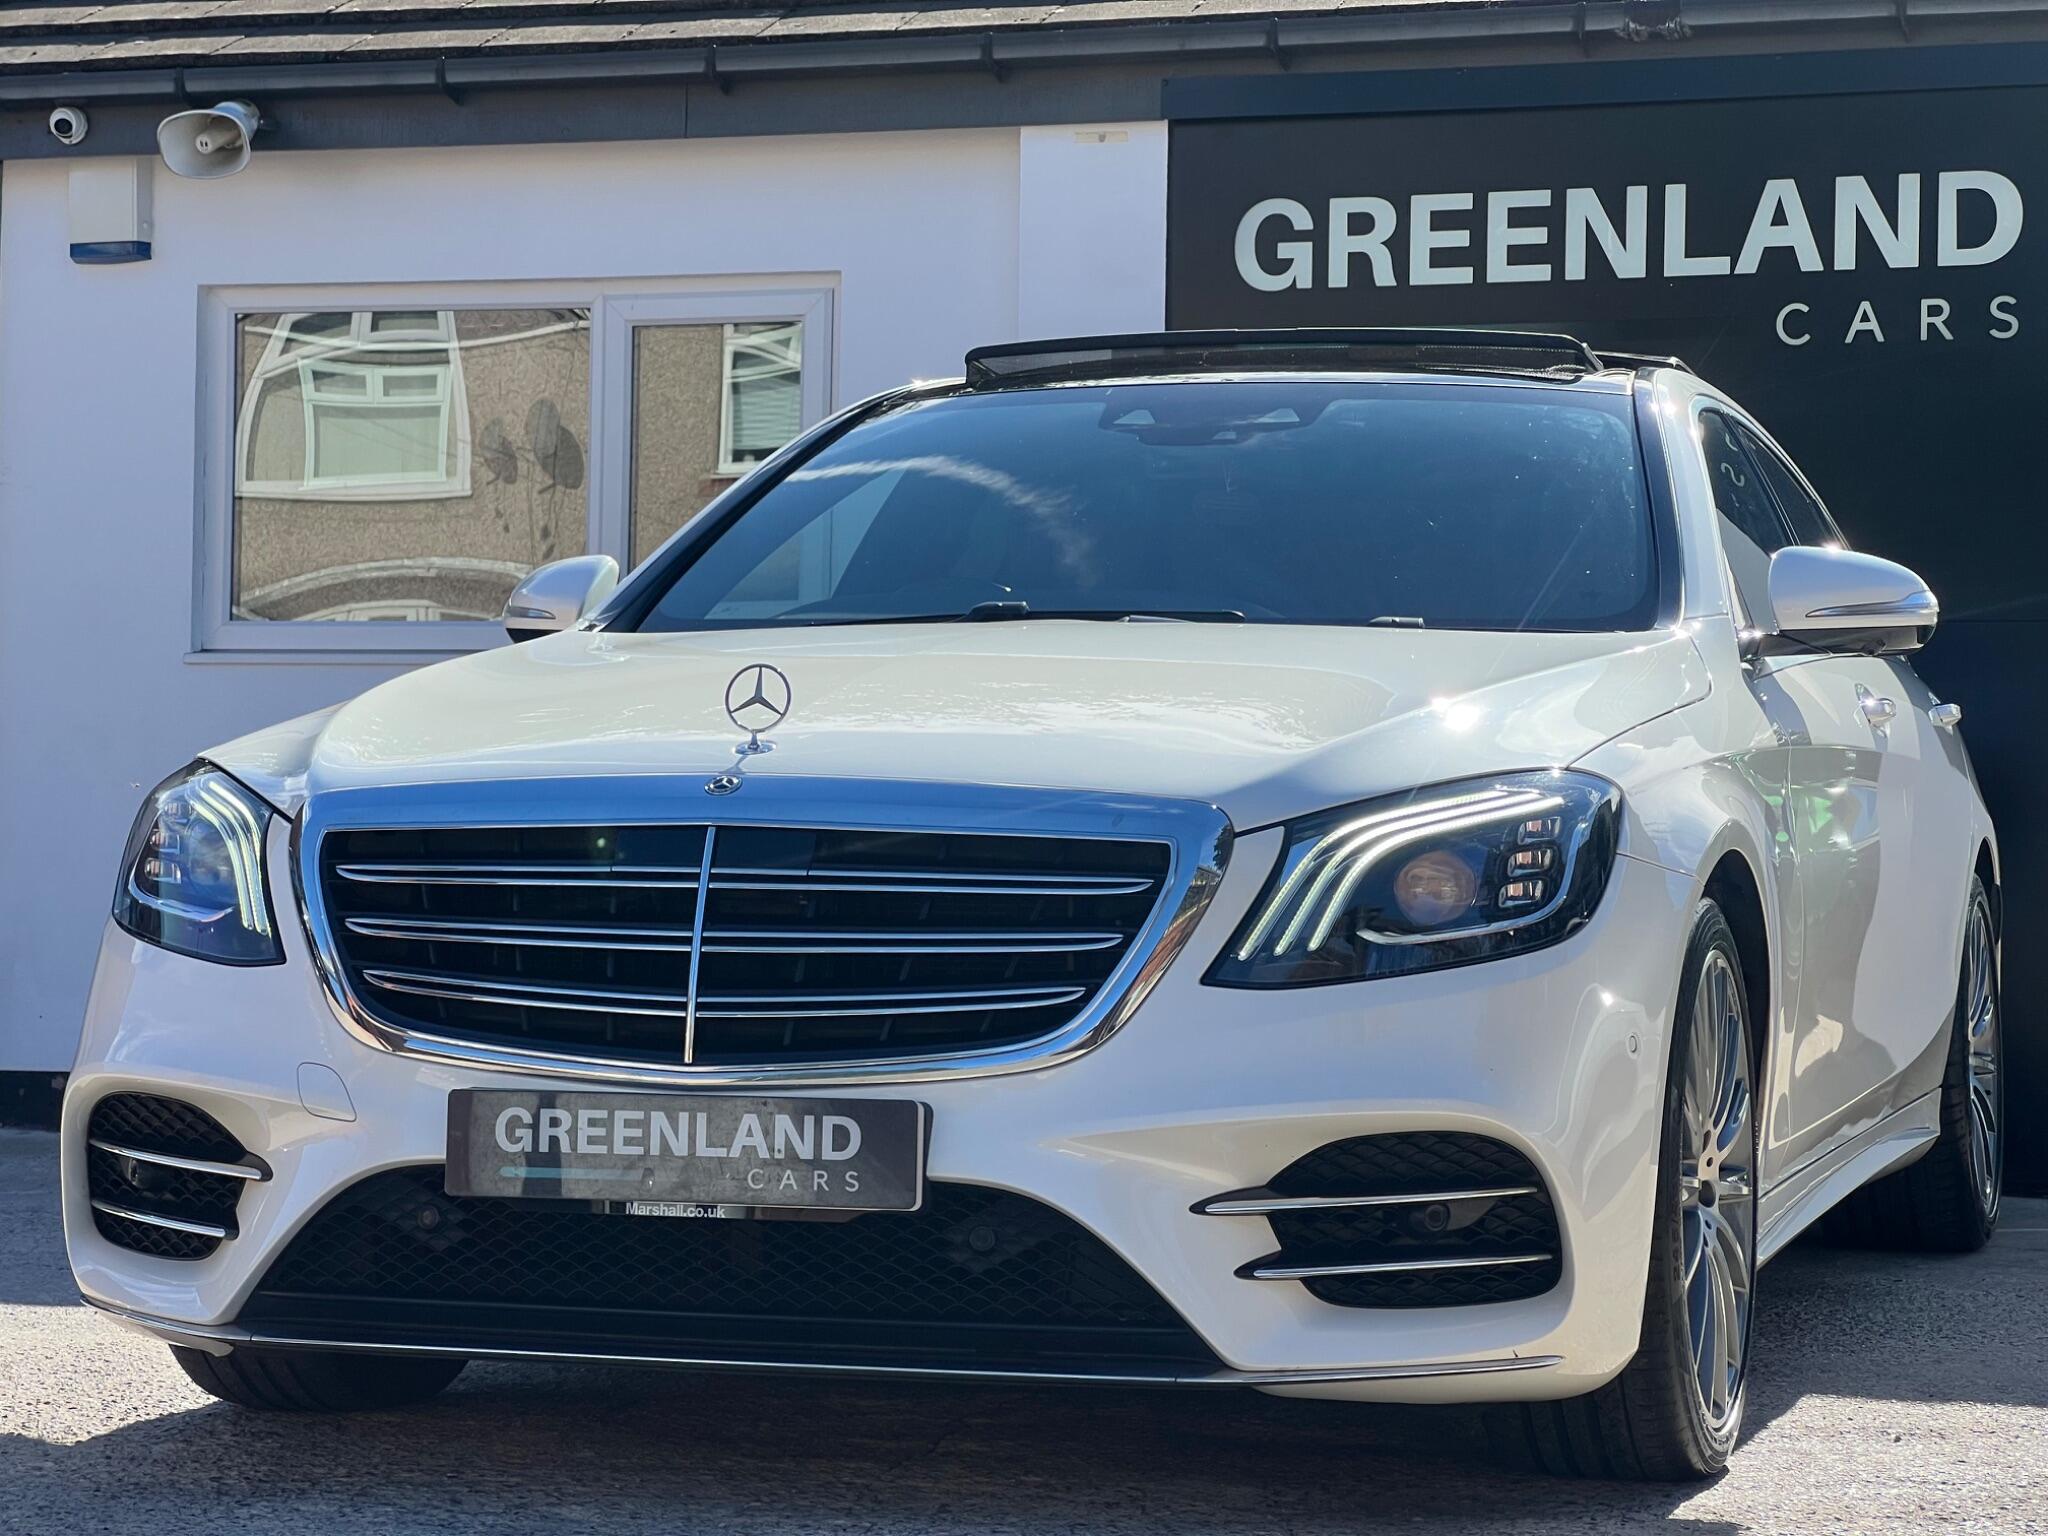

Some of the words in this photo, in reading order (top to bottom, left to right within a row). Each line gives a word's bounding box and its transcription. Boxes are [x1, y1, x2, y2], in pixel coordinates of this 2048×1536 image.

[1234, 170, 2024, 292] GREENLAND
[1776, 295, 2019, 346] CARS
[495, 1107, 862, 1161] GREENLAND
[747, 1168, 860, 1192] CARS
[625, 1201, 726, 1219] Marshall.co.uk
